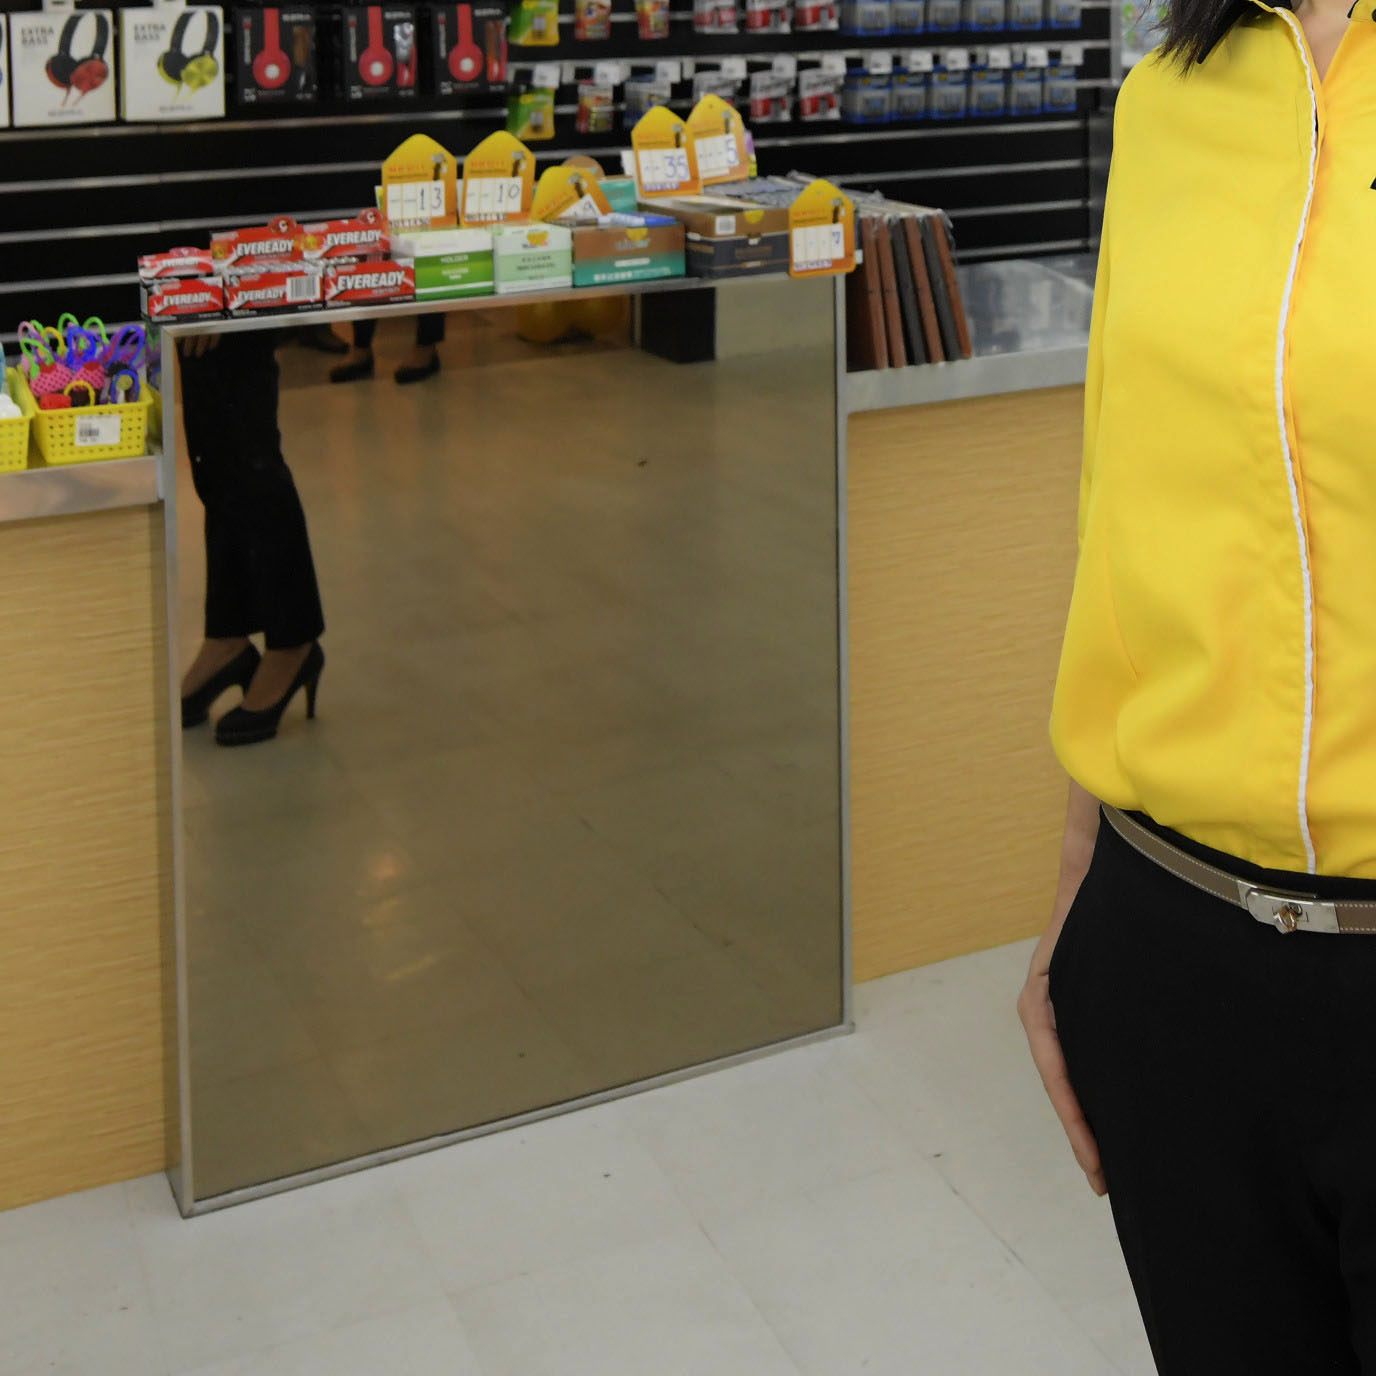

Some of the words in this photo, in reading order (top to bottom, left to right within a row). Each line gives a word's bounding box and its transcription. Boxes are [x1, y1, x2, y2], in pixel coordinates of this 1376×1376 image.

[662, 155, 689, 181] 35
[419, 186, 442, 212] 13
[497, 183, 520, 204] 10
[236, 238, 295, 257] EVEREADY
[327, 229, 382, 246] EVEREADY
[337, 270, 406, 291] EVEREADY
[163, 291, 212, 306] EVEREADY
[237, 288, 286, 303] EVEREADY
